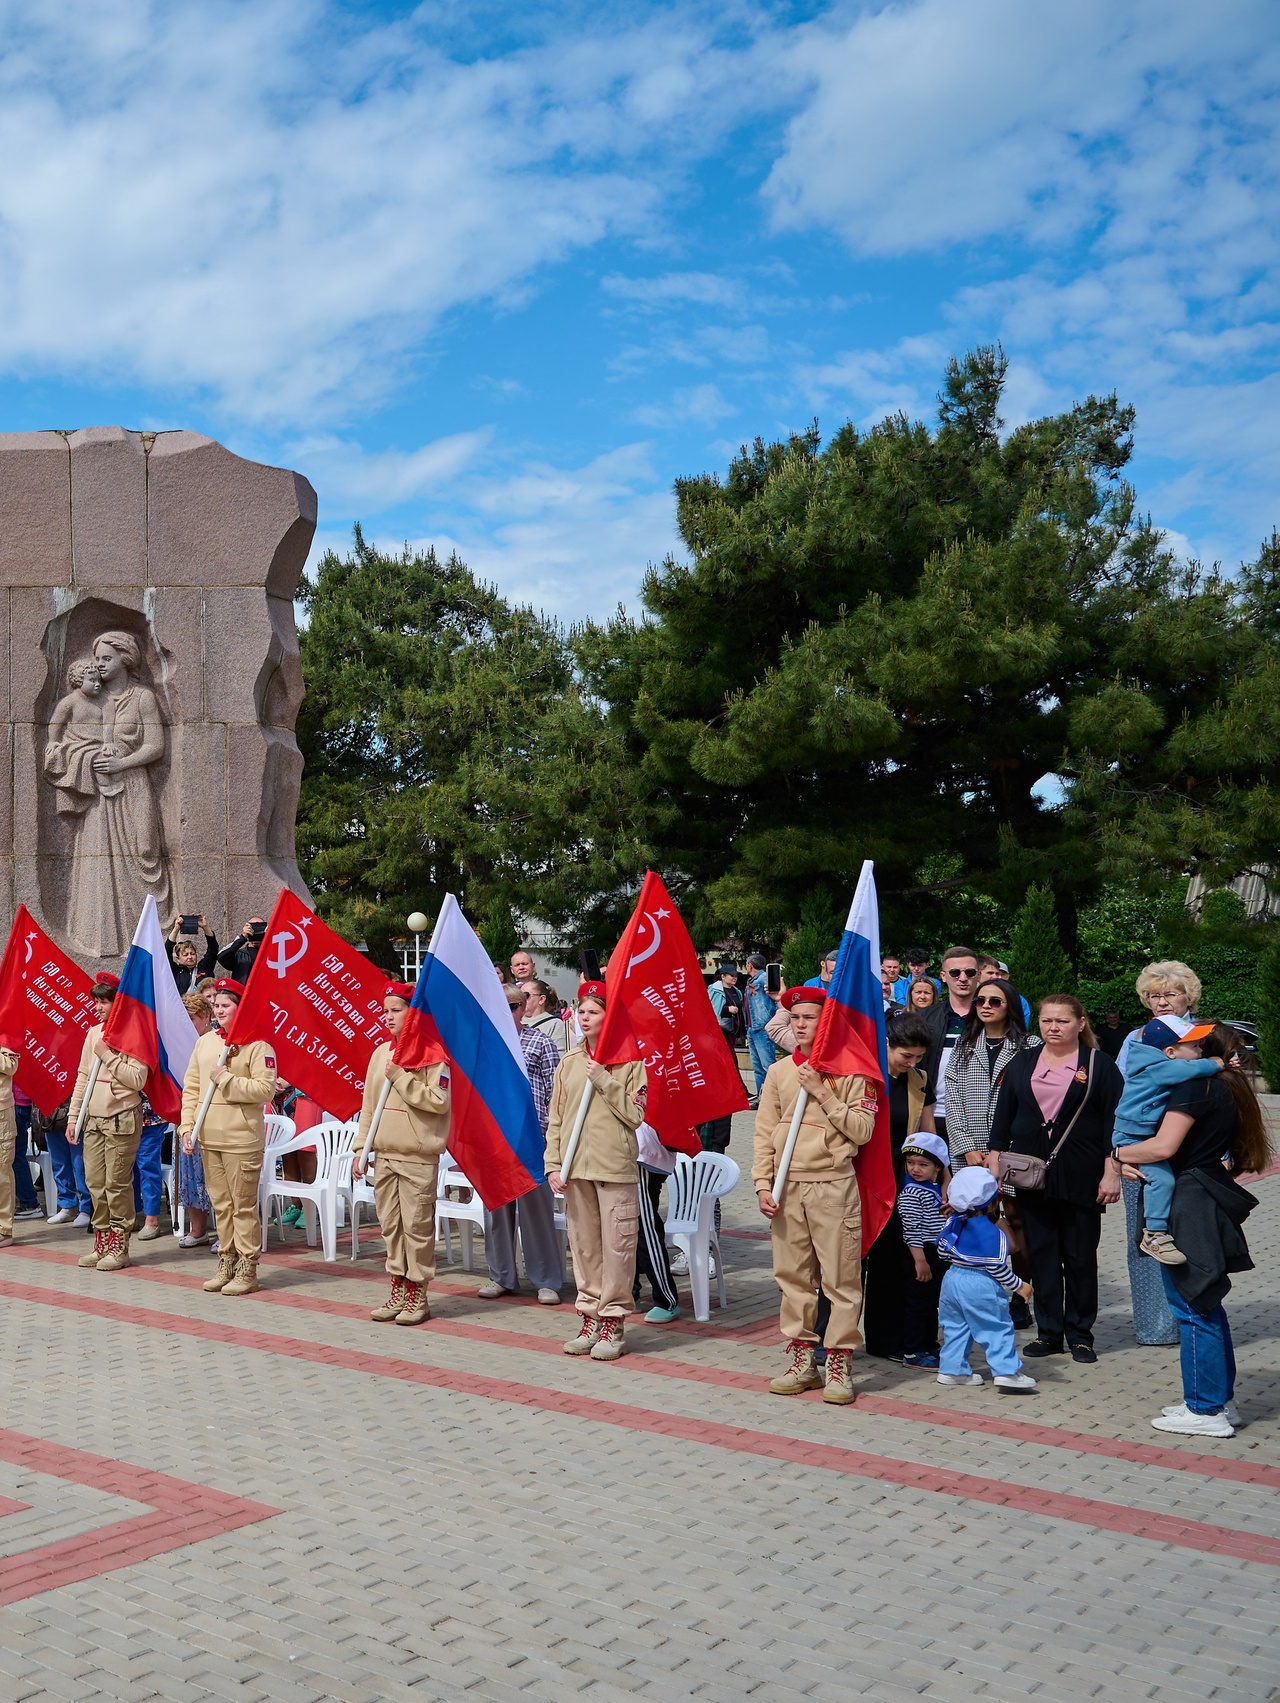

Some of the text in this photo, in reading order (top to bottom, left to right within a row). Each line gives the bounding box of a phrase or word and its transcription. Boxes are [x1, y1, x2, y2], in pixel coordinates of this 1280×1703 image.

[40, 960, 61, 977] 150
[320, 953, 345, 974] 150
[679, 1034, 706, 1089] ОРДЕНА
